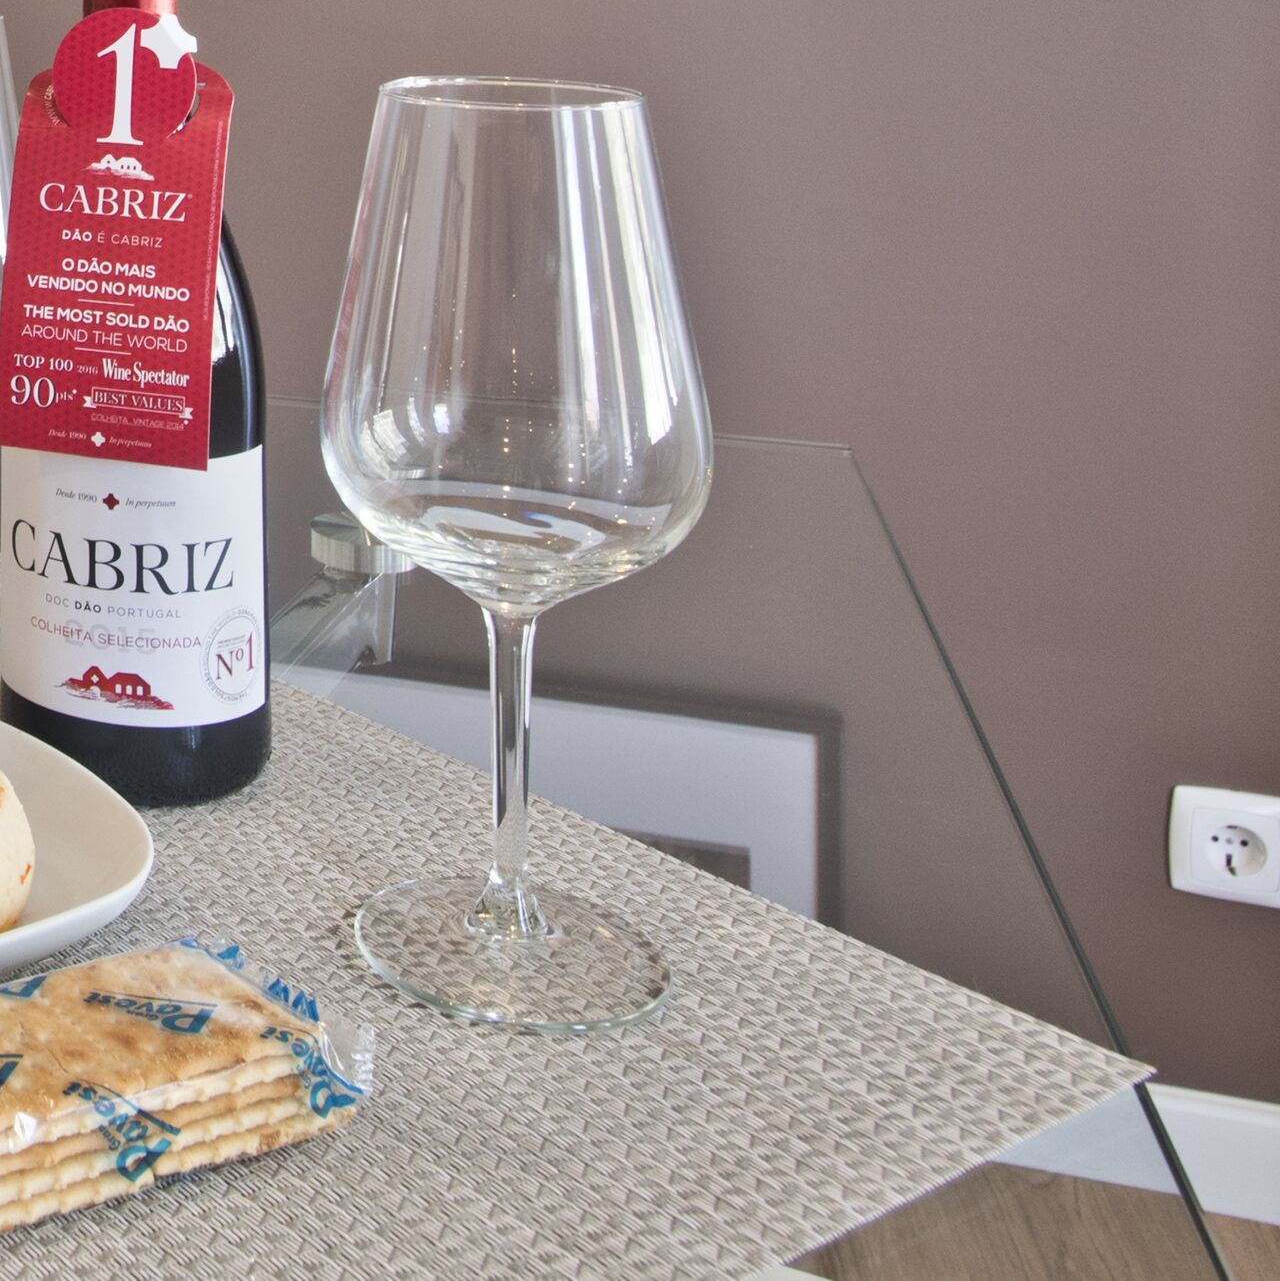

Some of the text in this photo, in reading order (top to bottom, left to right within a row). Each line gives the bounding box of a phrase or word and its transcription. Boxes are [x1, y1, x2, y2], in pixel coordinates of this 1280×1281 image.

[96, 22, 144, 146] 1
[39, 182, 188, 223] CABRIZ
[61, 228, 163, 249] DÃO É CABRIZ
[61, 257, 157, 279] O DÃO MAIS
[27, 274, 190, 302] VENDIDO NO MUNDO
[23, 304, 190, 333] THE MOST SOLD DÃO
[21, 324, 188, 353] AROUND THE WORLD
[13, 353, 190, 388] TOP 100 2016 Wine Spectator
[94, 391, 183, 412] BEST VALUES
[11, 518, 235, 596] CABRIZ
[45, 592, 183, 620] DOC DÃO PORTUGAL
[30, 615, 94, 643] COLHEITA
[97, 632, 203, 650] SELECIONADA
[62, 1080, 173, 1183] Pavesi
